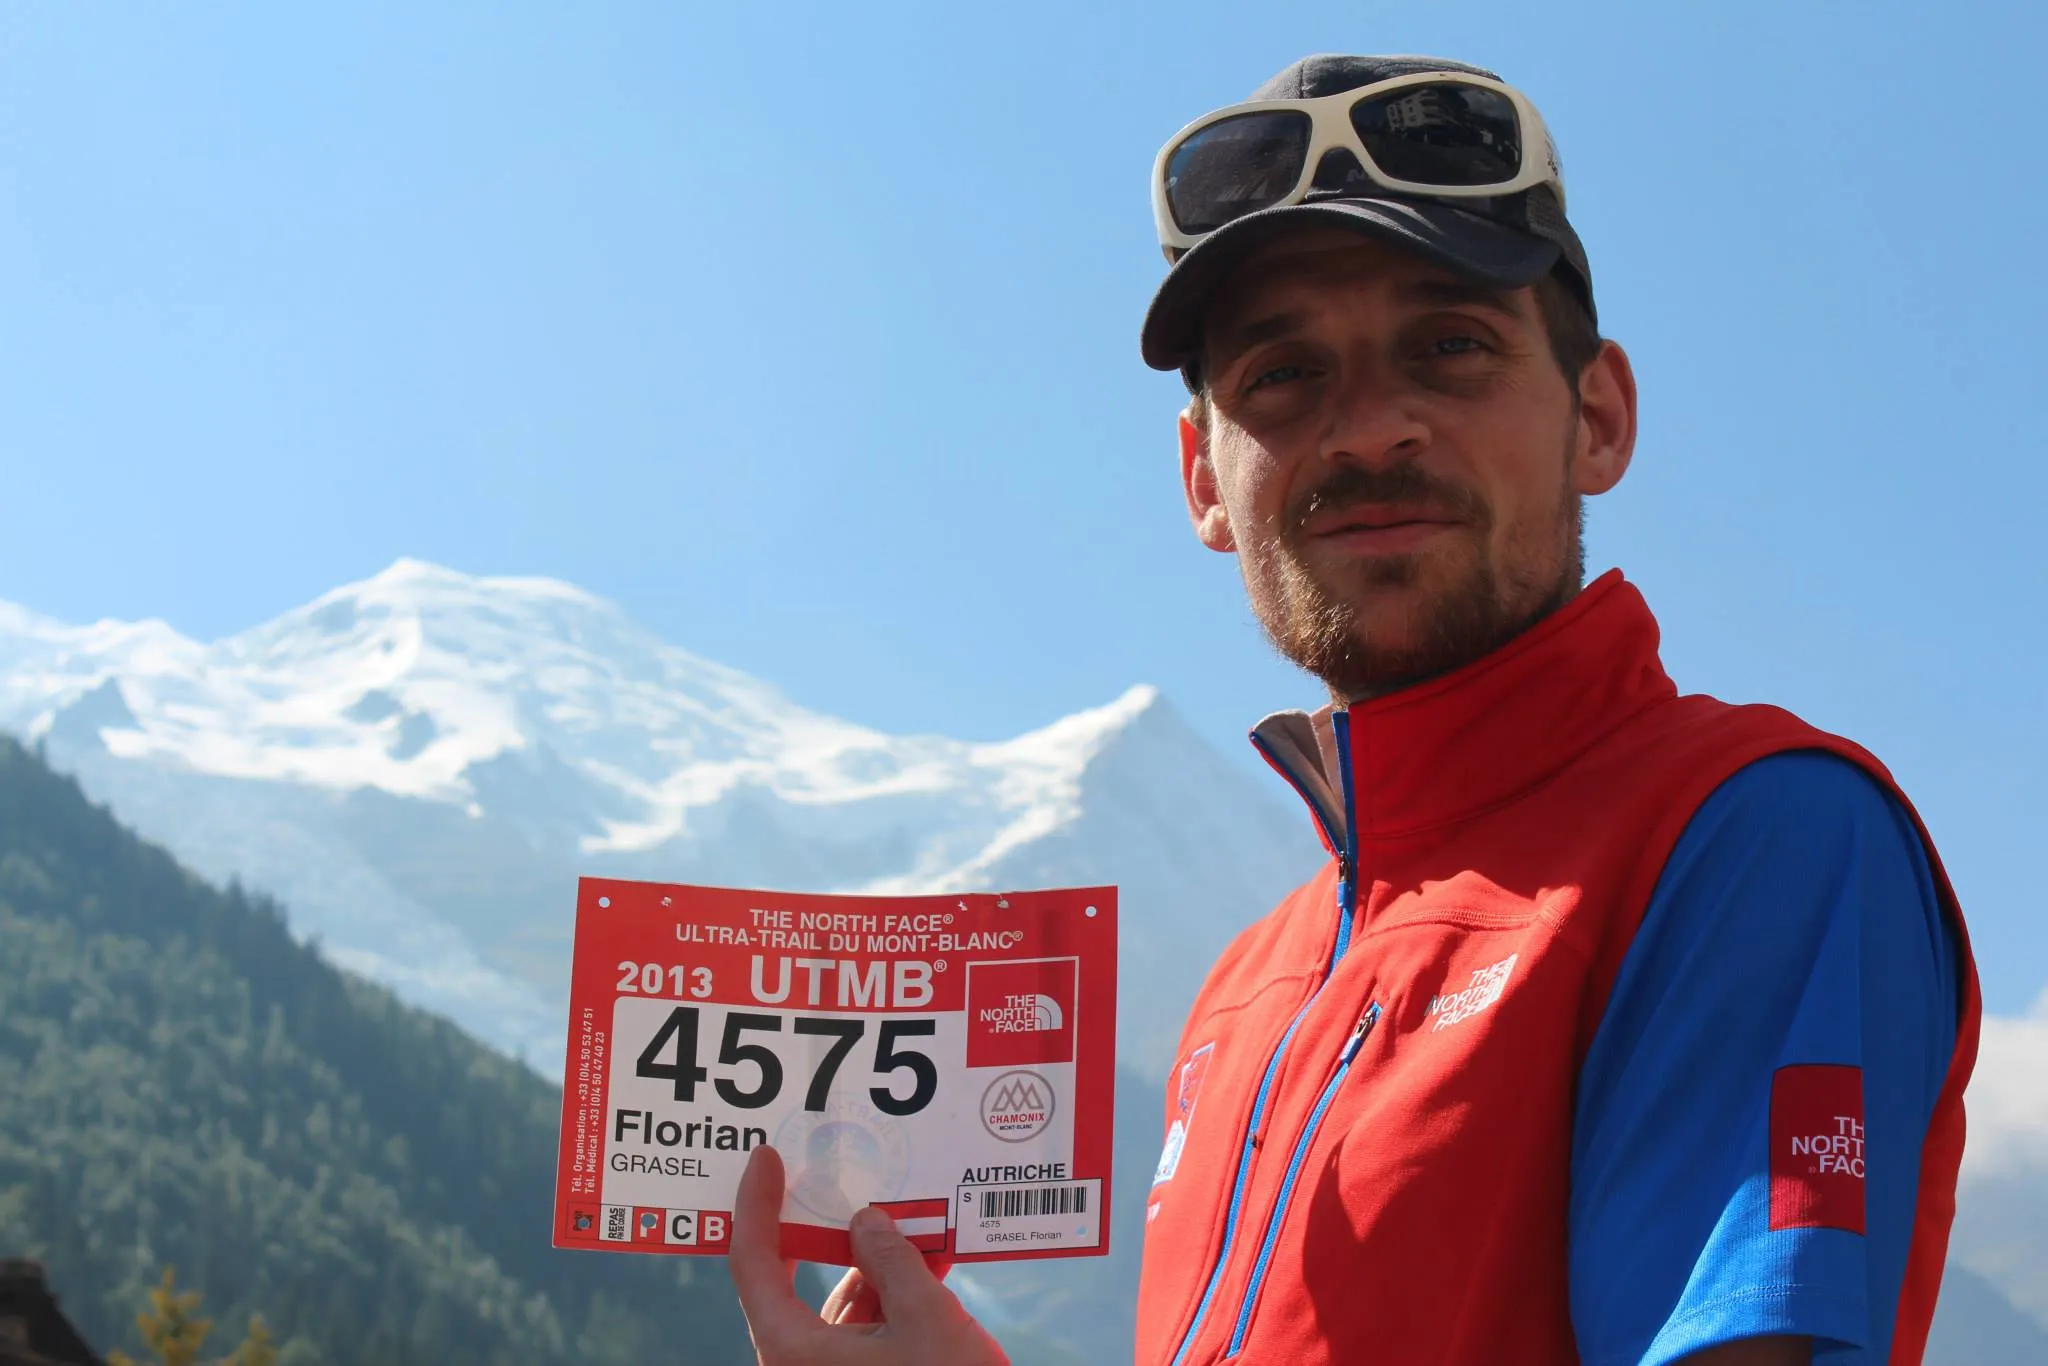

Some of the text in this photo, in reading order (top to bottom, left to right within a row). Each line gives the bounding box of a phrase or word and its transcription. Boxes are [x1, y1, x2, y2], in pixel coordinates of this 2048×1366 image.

[749, 908, 793, 929] THE
[800, 911, 877, 933] NORTH
[676, 923, 823, 951] ULTRA-TRAIL
[829, 933, 860, 953] DU
[616, 960, 713, 998] 2013
[1468, 960, 1506, 988] THE
[1004, 994, 1035, 1008] THE
[583, 1007, 594, 1019] 51
[980, 1007, 1035, 1022] NORTH
[583, 1020, 593, 1033] 47
[995, 1019, 1035, 1033] FACE
[595, 1031, 605, 1044] 23
[581, 1048, 591, 1060] 50
[594, 1045, 604, 1057] 40
[636, 1006, 938, 1116] 4575
[593, 1058, 603, 1071] 47
[592, 1073, 602, 1085] 50
[989, 1112, 1045, 1125] CHAMONIX
[1833, 1116, 1865, 1138] TH
[573, 1109, 587, 1172] Organisation
[614, 1108, 767, 1152] Florian
[586, 1134, 598, 1173] Médical
[1792, 1135, 1865, 1157] NORT
[610, 1152, 710, 1178] GRASEL
[961, 1162, 1066, 1184] AUTRICHE
[1819, 1154, 1865, 1179] FAC
[963, 1192, 972, 1203] S
[608, 1207, 619, 1239] REPAS
[671, 1214, 692, 1240] C
[704, 1215, 725, 1241] B
[979, 1220, 1001, 1229] 4575
[986, 1231, 1062, 1243] GRASEL Florian
